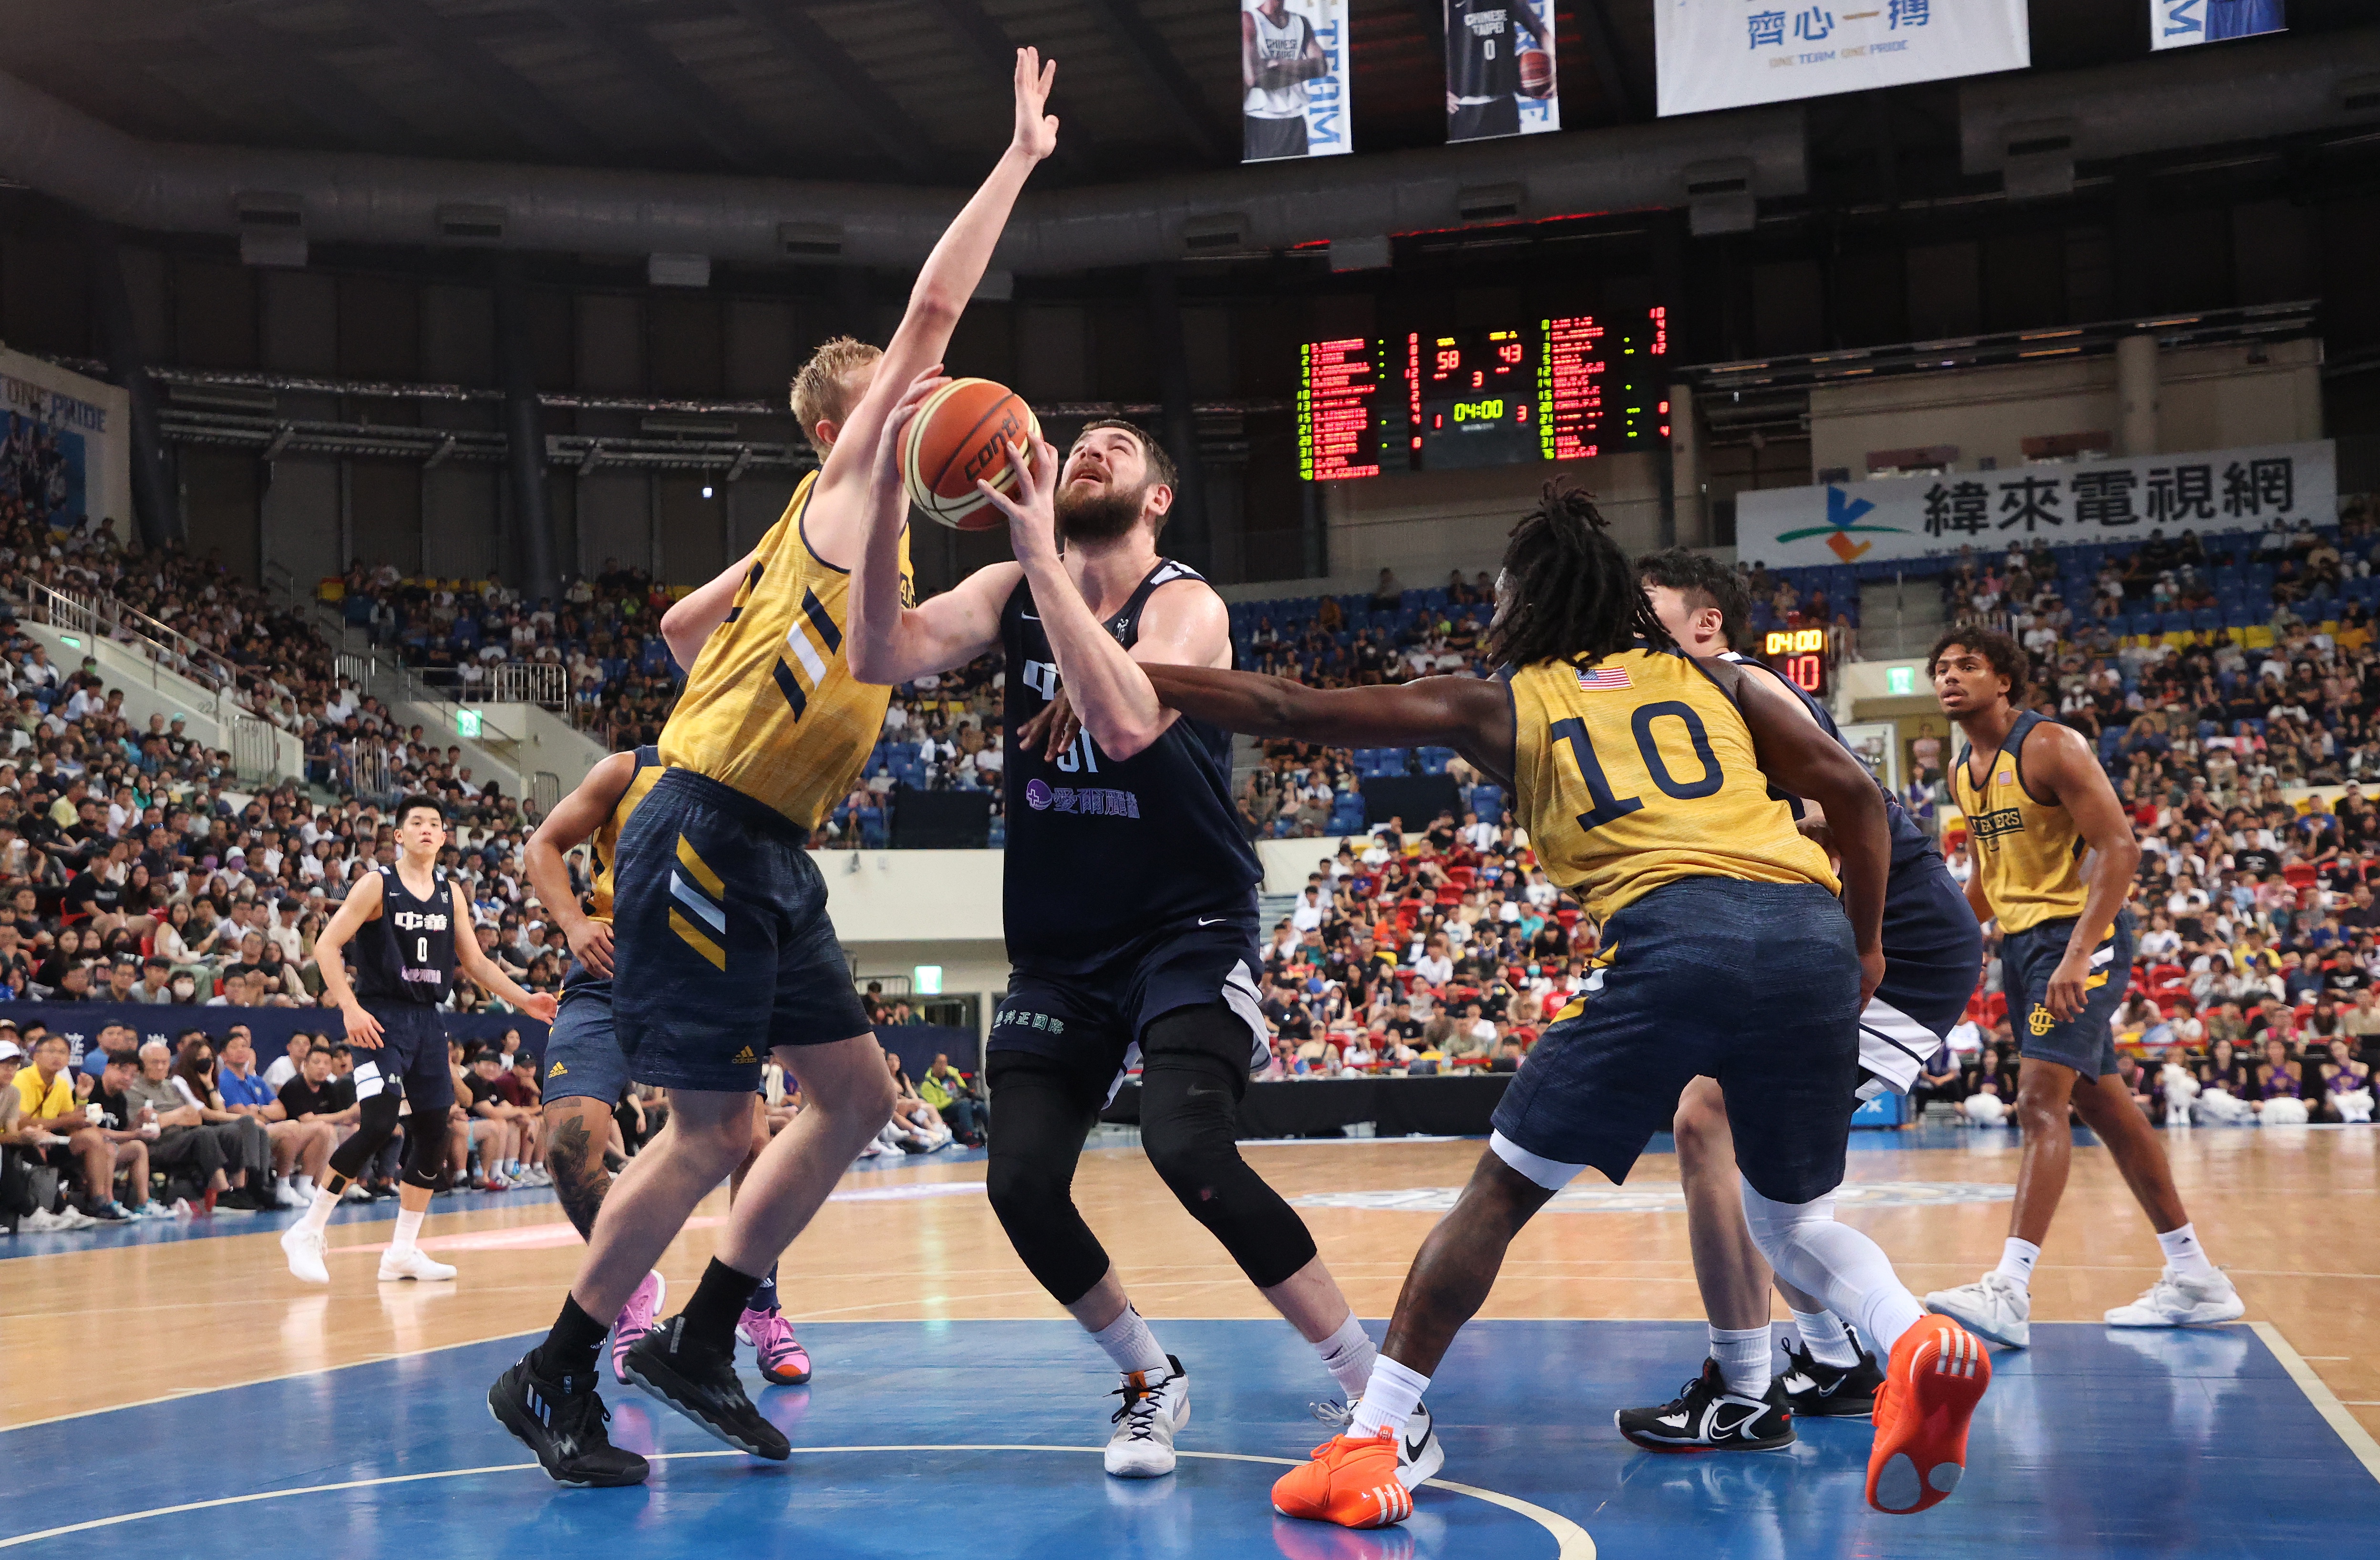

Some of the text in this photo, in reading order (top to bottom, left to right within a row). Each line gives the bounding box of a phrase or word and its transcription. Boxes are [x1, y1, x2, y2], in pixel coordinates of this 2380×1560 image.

[1483, 39, 1496, 60] 0
[1649, 307, 1666, 319] 10
[1541, 320, 1549, 330] 0
[1655, 319, 1666, 329] 4
[1409, 333, 1419, 344] 8
[1545, 331, 1550, 341] 1
[1656, 331, 1666, 342] 5
[1301, 344, 1309, 354] 0
[1410, 345, 1419, 356] 8
[1543, 342, 1550, 353] 3
[1651, 342, 1667, 354] 12
[1498, 344, 1523, 363] 43
[1301, 356, 1309, 366] 2
[1410, 356, 1419, 367] 6
[1437, 350, 1460, 371] 58
[1543, 354, 1550, 365] 5
[1302, 367, 1309, 377] 3
[1404, 368, 1420, 379] 12
[1537, 366, 1551, 377] 12
[1302, 379, 1309, 387] 4
[1410, 379, 1420, 390] 6
[1472, 371, 1484, 388] 3
[1537, 378, 1552, 389] 14
[1297, 390, 1310, 400] 10
[1410, 391, 1420, 402] 2
[1538, 390, 1552, 401] 15
[1298, 401, 1310, 412] 13
[1411, 403, 1421, 413] 4
[1454, 399, 1503, 422] 04:00
[1659, 402, 1669, 413] 8
[1298, 413, 1311, 423] 15
[1412, 414, 1422, 424] 4
[1516, 405, 1528, 423] 3
[1539, 413, 1553, 425] 21
[1435, 414, 1442, 429] 1
[1298, 424, 1311, 435] 21
[1659, 426, 1670, 437] 4
[1412, 437, 1422, 449] 8
[1541, 437, 1555, 448] 31
[1299, 447, 1312, 458] 31
[1924, 457, 2295, 537] 緯來電視網
[1787, 655, 1820, 691] 10
[1551, 700, 1724, 833] 10
[417, 937, 428, 963] 0
[548, 1068, 568, 1078] adidas
